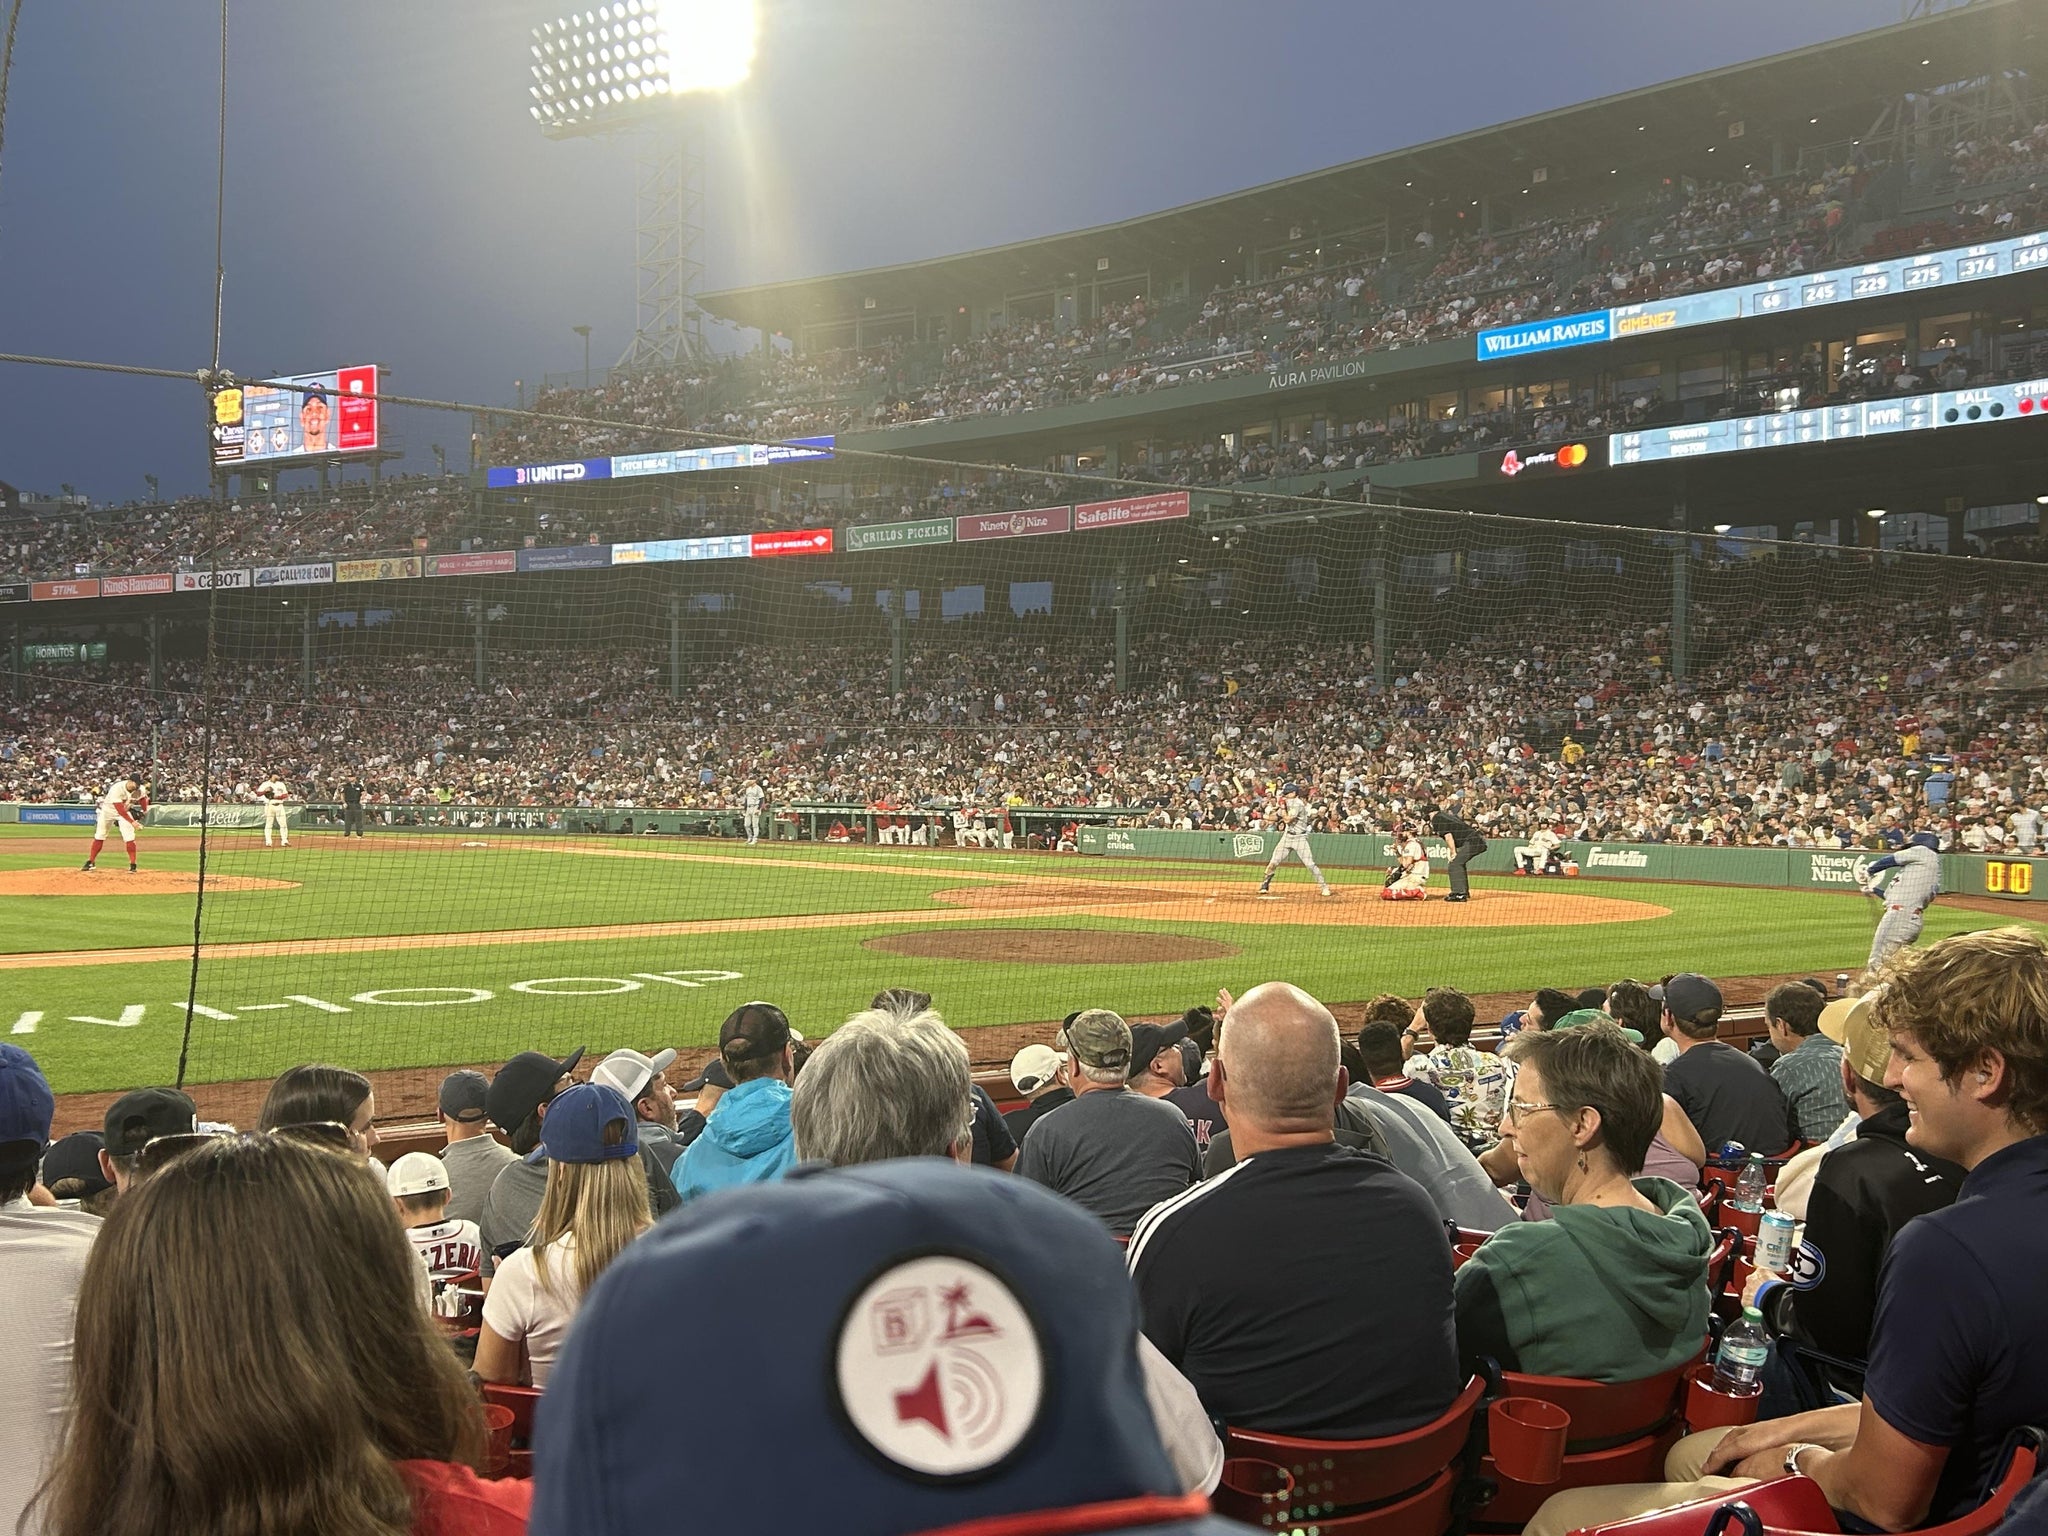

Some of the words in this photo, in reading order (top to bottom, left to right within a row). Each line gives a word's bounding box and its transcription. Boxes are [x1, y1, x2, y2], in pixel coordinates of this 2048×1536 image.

[2014, 247, 2048, 267] .649
[1960, 257, 1995, 276] .374
[1906, 267, 1941, 285] .275
[1855, 276, 1887, 293] .229
[1806, 285, 1834, 301] 245
[1618, 310, 1677, 333] GIMÉNEZ
[1485, 328, 1551, 352] WILLIAM
[1552, 319, 1605, 341] RAVEIS
[1310, 361, 1365, 381] PAVILION
[1911, 399, 1921, 412] 4
[1955, 391, 1994, 405] BALL
[1869, 408, 1900, 426] MVR
[1668, 427, 1709, 440] TORONTO
[531, 463, 586, 482] UNITED
[1078, 507, 1130, 524] Safelite
[907, 525, 949, 540] PICKLES
[980, 520, 1009, 532] Ninety
[1026, 517, 1048, 527] Nine
[280, 567, 331, 581] CALL128.COM
[52, 585, 78, 596] STIHL
[103, 579, 128, 594] King's
[129, 578, 169, 592] Hawaiian
[35, 648, 74, 658] HORNITOS
[1107, 833, 1122, 842] city
[1811, 855, 1855, 869] Ninety
[1811, 867, 1853, 882] Nine
